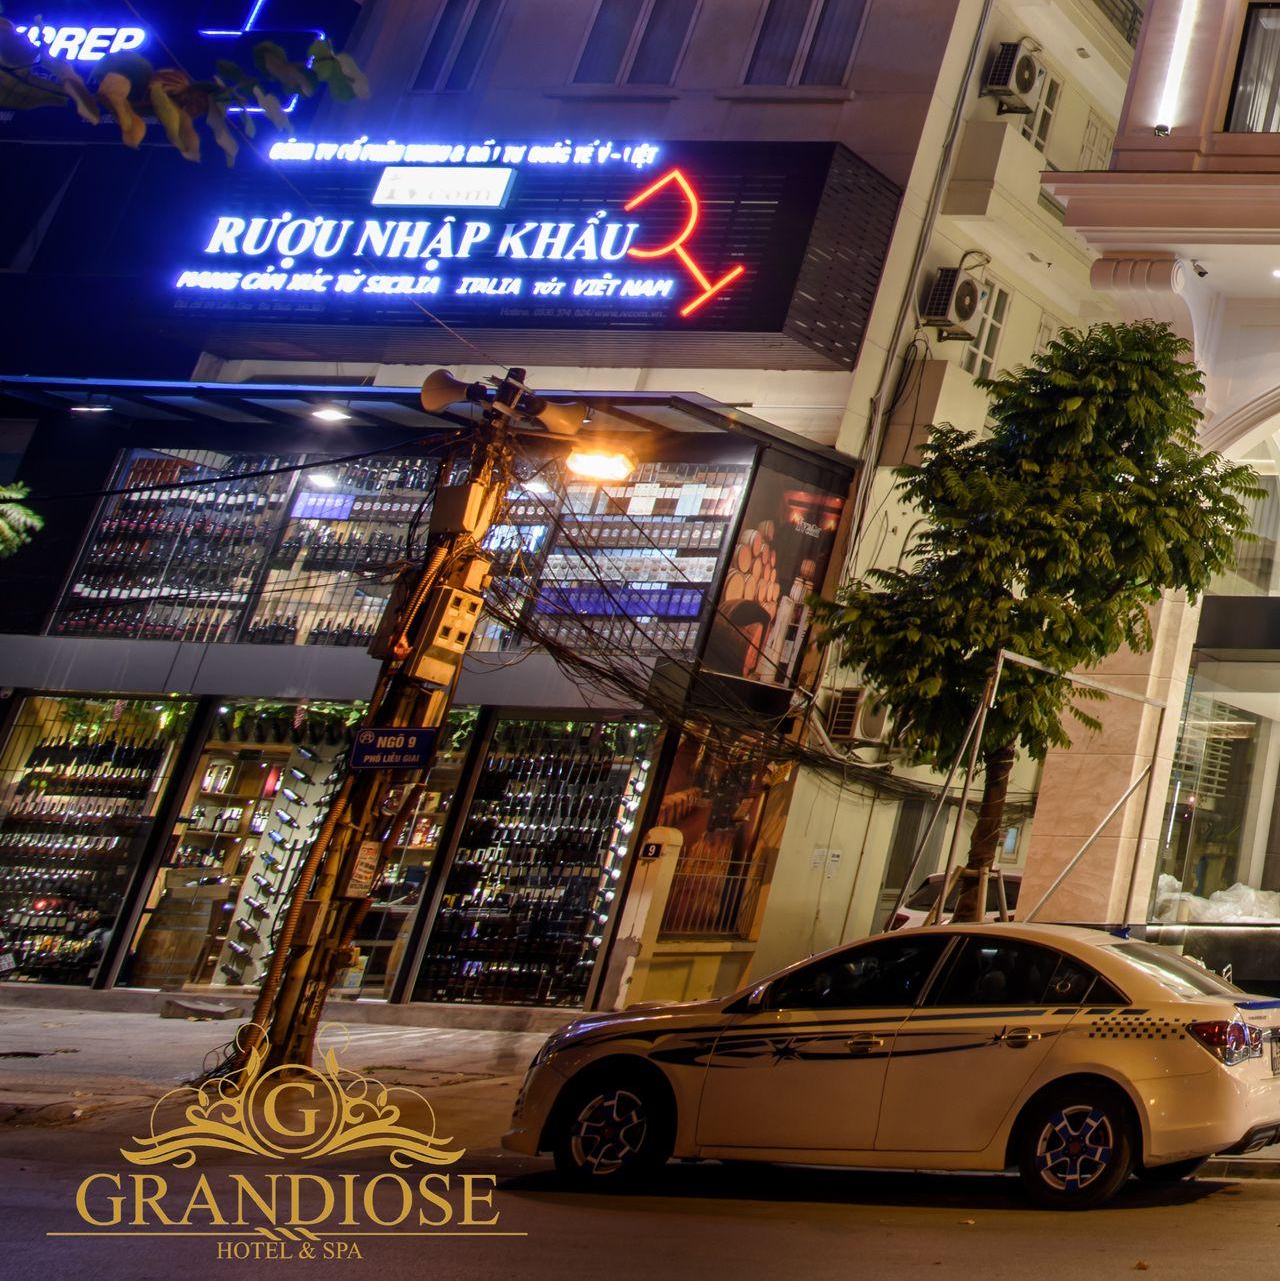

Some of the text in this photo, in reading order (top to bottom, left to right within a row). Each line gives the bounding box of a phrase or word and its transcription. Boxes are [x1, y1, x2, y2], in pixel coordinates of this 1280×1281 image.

[205, 210, 640, 271] RƯỢU NHẬP KHẨU
[456, 278, 522, 295] ITALIA
[572, 273, 621, 296] VIỆT
[620, 279, 674, 297] NAM
[377, 733, 417, 748] NGÕ 9
[402, 754, 420, 762] GIAI
[648, 845, 656, 856] 9
